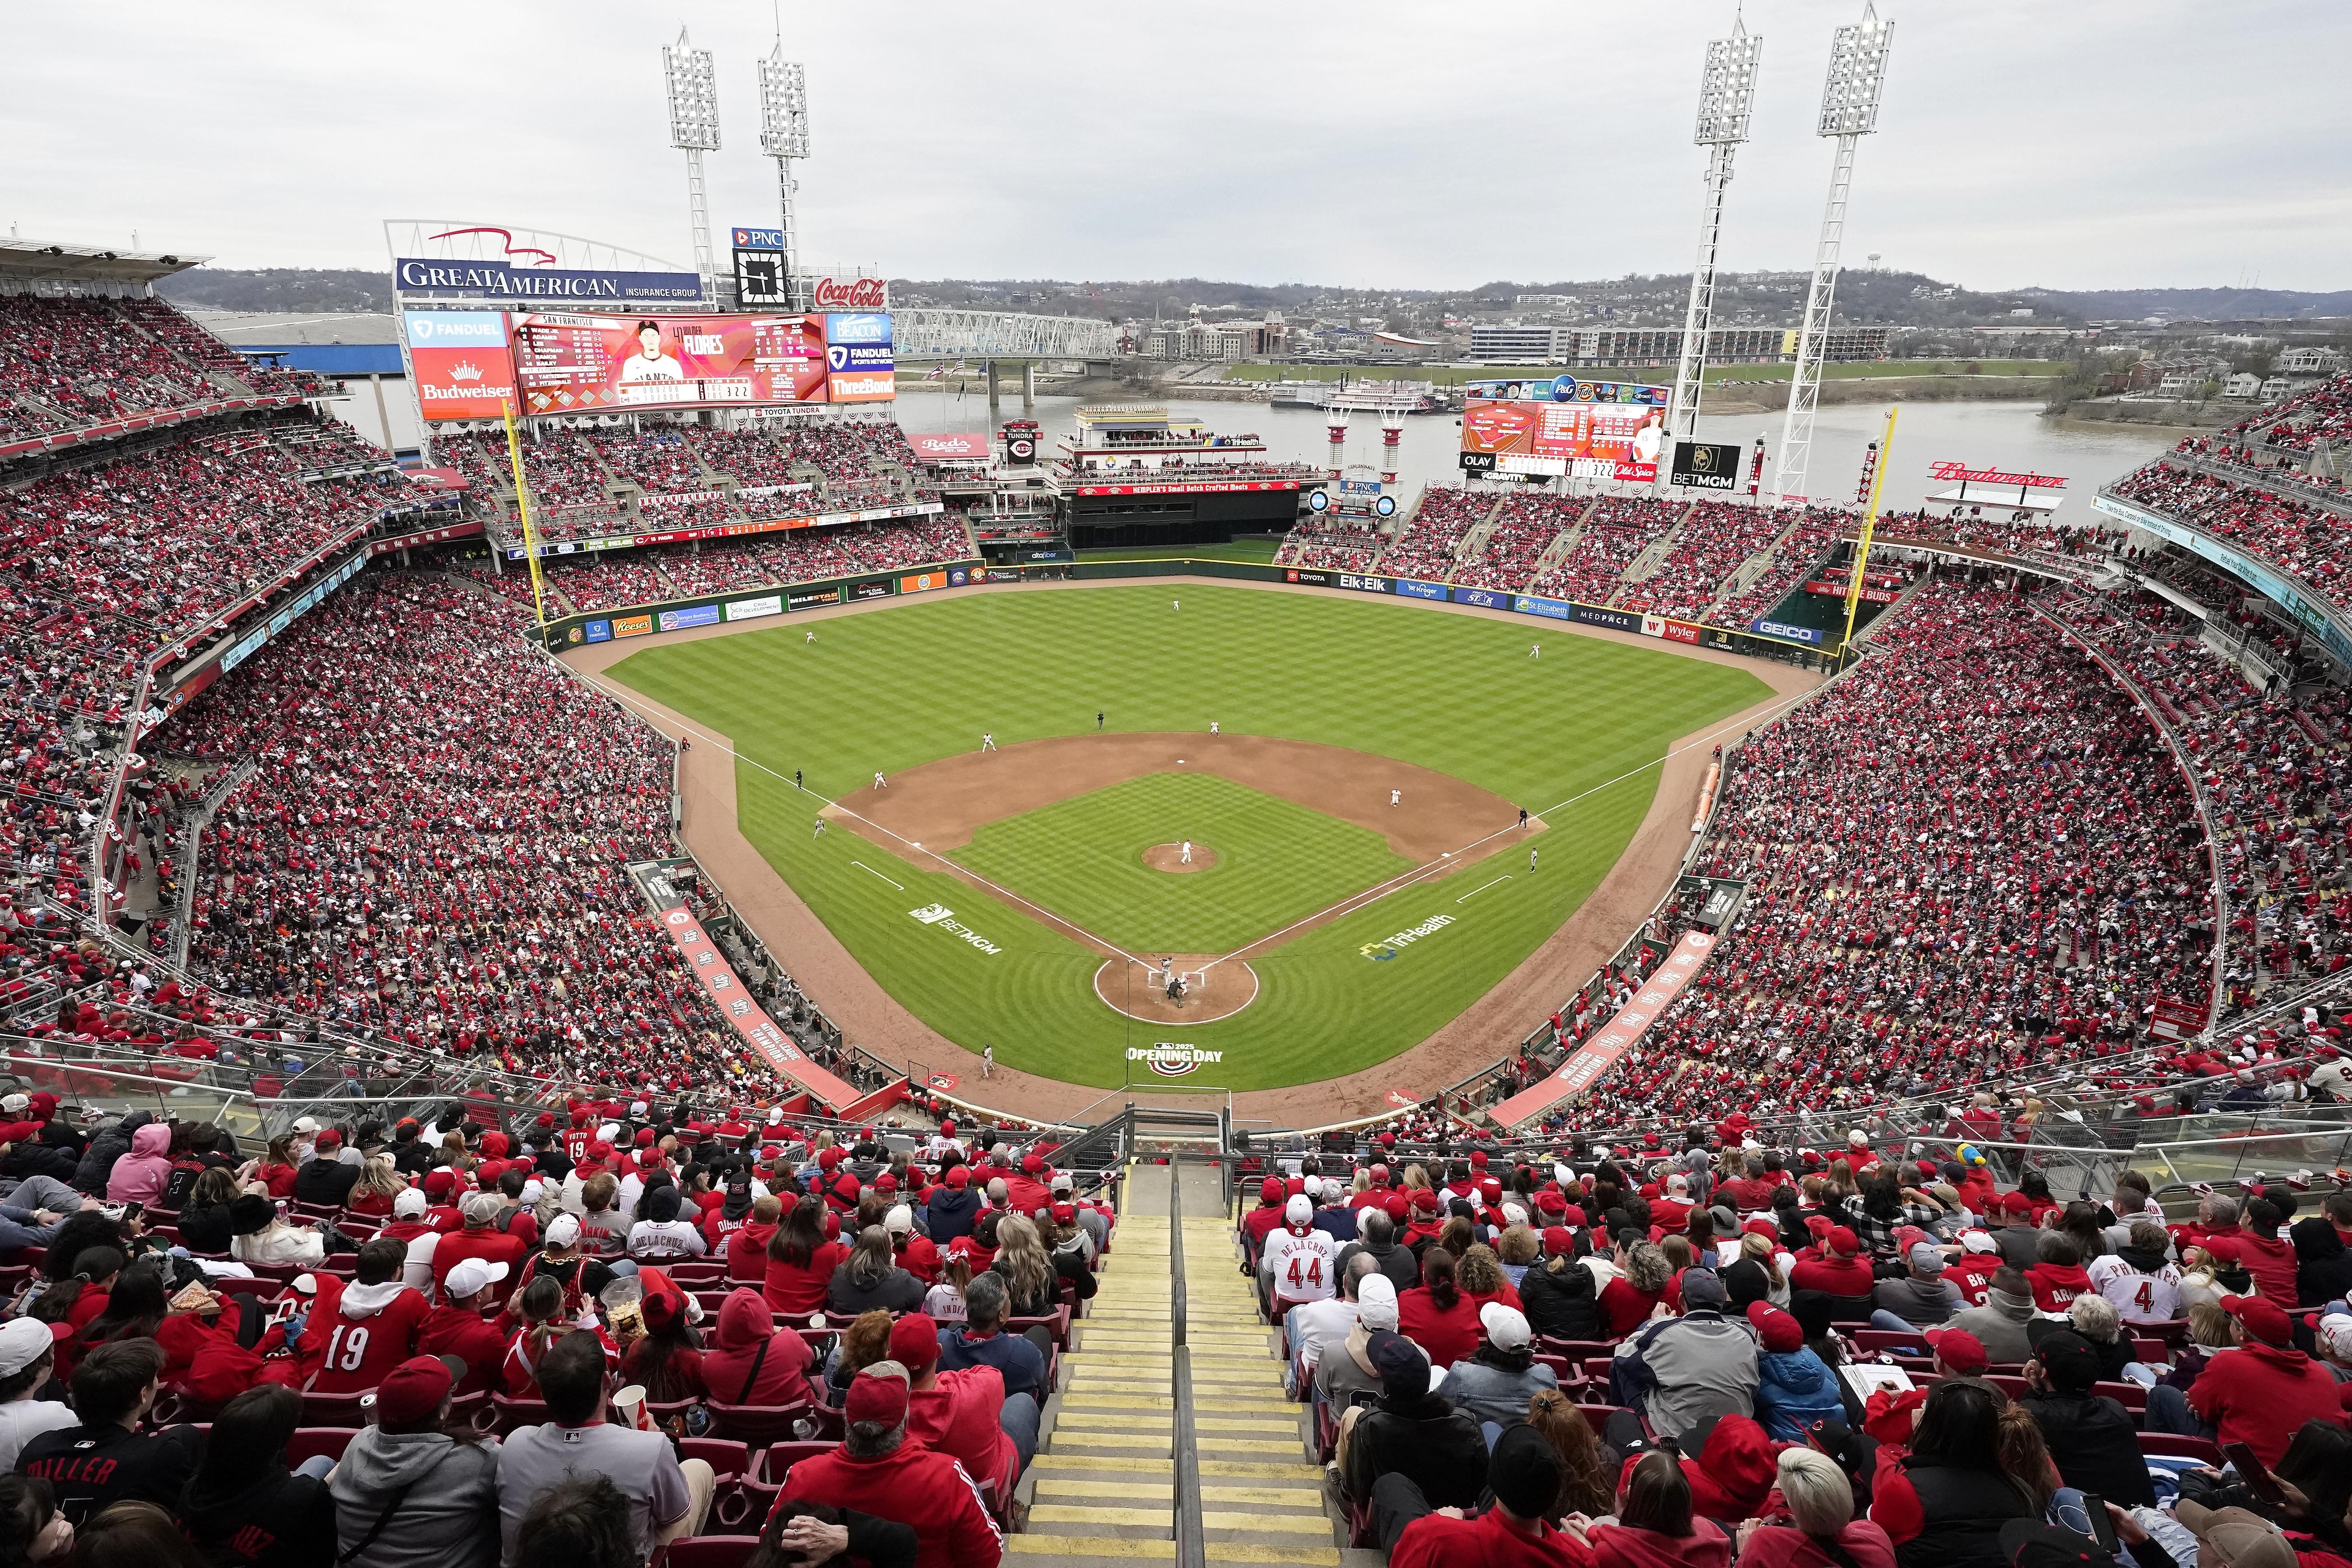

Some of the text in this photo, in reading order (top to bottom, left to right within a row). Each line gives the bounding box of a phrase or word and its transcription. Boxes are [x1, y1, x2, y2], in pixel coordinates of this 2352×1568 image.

[750, 232, 782, 246] PNC
[626, 288, 669, 297] INSURANCE
[815, 278, 887, 306] Coca-Cola
[560, 317, 593, 326] FRANCISCO
[437, 324, 499, 335] FANDUEL
[684, 326, 702, 335] WILMER
[836, 322, 881, 337] BEACON
[684, 335, 724, 355] FLORES
[851, 349, 893, 358] FANDUEL
[422, 384, 512, 399] Budweiser
[831, 378, 894, 395] ThreeBond
[1555, 384, 1574, 394] P&G
[1578, 386, 1592, 396] Tide
[922, 438, 971, 451] Reds
[1877, 441, 1885, 464] ROOT
[1464, 456, 1491, 466] OLAY
[1487, 471, 1525, 482] GRAVITY
[1615, 464, 1654, 480] Old Spice
[1932, 461, 2065, 488] Budweiser
[1673, 473, 1733, 488] BETMGM
[1133, 484, 1166, 493] HEMPLER'S
[923, 505, 937, 513] ROSE
[2125, 511, 2136, 522] Carpool
[2161, 525, 2171, 537] Driving
[608, 538, 633, 548] $163,495
[2220, 553, 2230, 567] Refuel
[1300, 573, 1325, 582] TOYOTA
[1340, 575, 1385, 592] Elk+Elk
[1415, 583, 1438, 597] Kroger
[1832, 586, 1891, 602] HIT BUDS
[744, 604, 779, 613] DEVELOPMENT
[1537, 603, 1567, 614] Elizabeth
[1580, 611, 1628, 625] MEDPACE
[616, 620, 650, 633] Reese's
[1668, 625, 1697, 639] Wyler
[1759, 622, 1812, 640] GEICO
[1708, 641, 1733, 650] BETMGM
[938, 919, 1002, 955] BETMGM
[1384, 914, 1457, 948] TriHealth
[716, 973, 729, 989] 1970
[734, 998, 747, 1014] 1972
[1626, 1012, 1646, 1027] 1940
[748, 1028, 790, 1064] CHAMPIONS
[759, 1022, 801, 1061] NATIONAL LEAGUE
[1604, 1034, 1624, 1049] 1919
[1126, 1047, 1223, 1063] OPENING DAY
[1558, 1051, 1593, 1080] WORLD SERIES
[1567, 1054, 1608, 1087] CHAMPIONS
[568, 1131, 588, 1140] VOTTO
[568, 1140, 585, 1158] 19
[636, 1235, 684, 1248] DE LA CRUZ
[1281, 1240, 1329, 1259] DE LA CRUZ
[1287, 1257, 1324, 1289] 44
[2109, 1262, 2180, 1287] PHIIPS
[2134, 1281, 2155, 1314] 4
[943, 1305, 965, 1316] INDIA
[2326, 1327, 2336, 1340] 11
[325, 1324, 368, 1371] 19
[27, 1458, 118, 1485] MILLER
